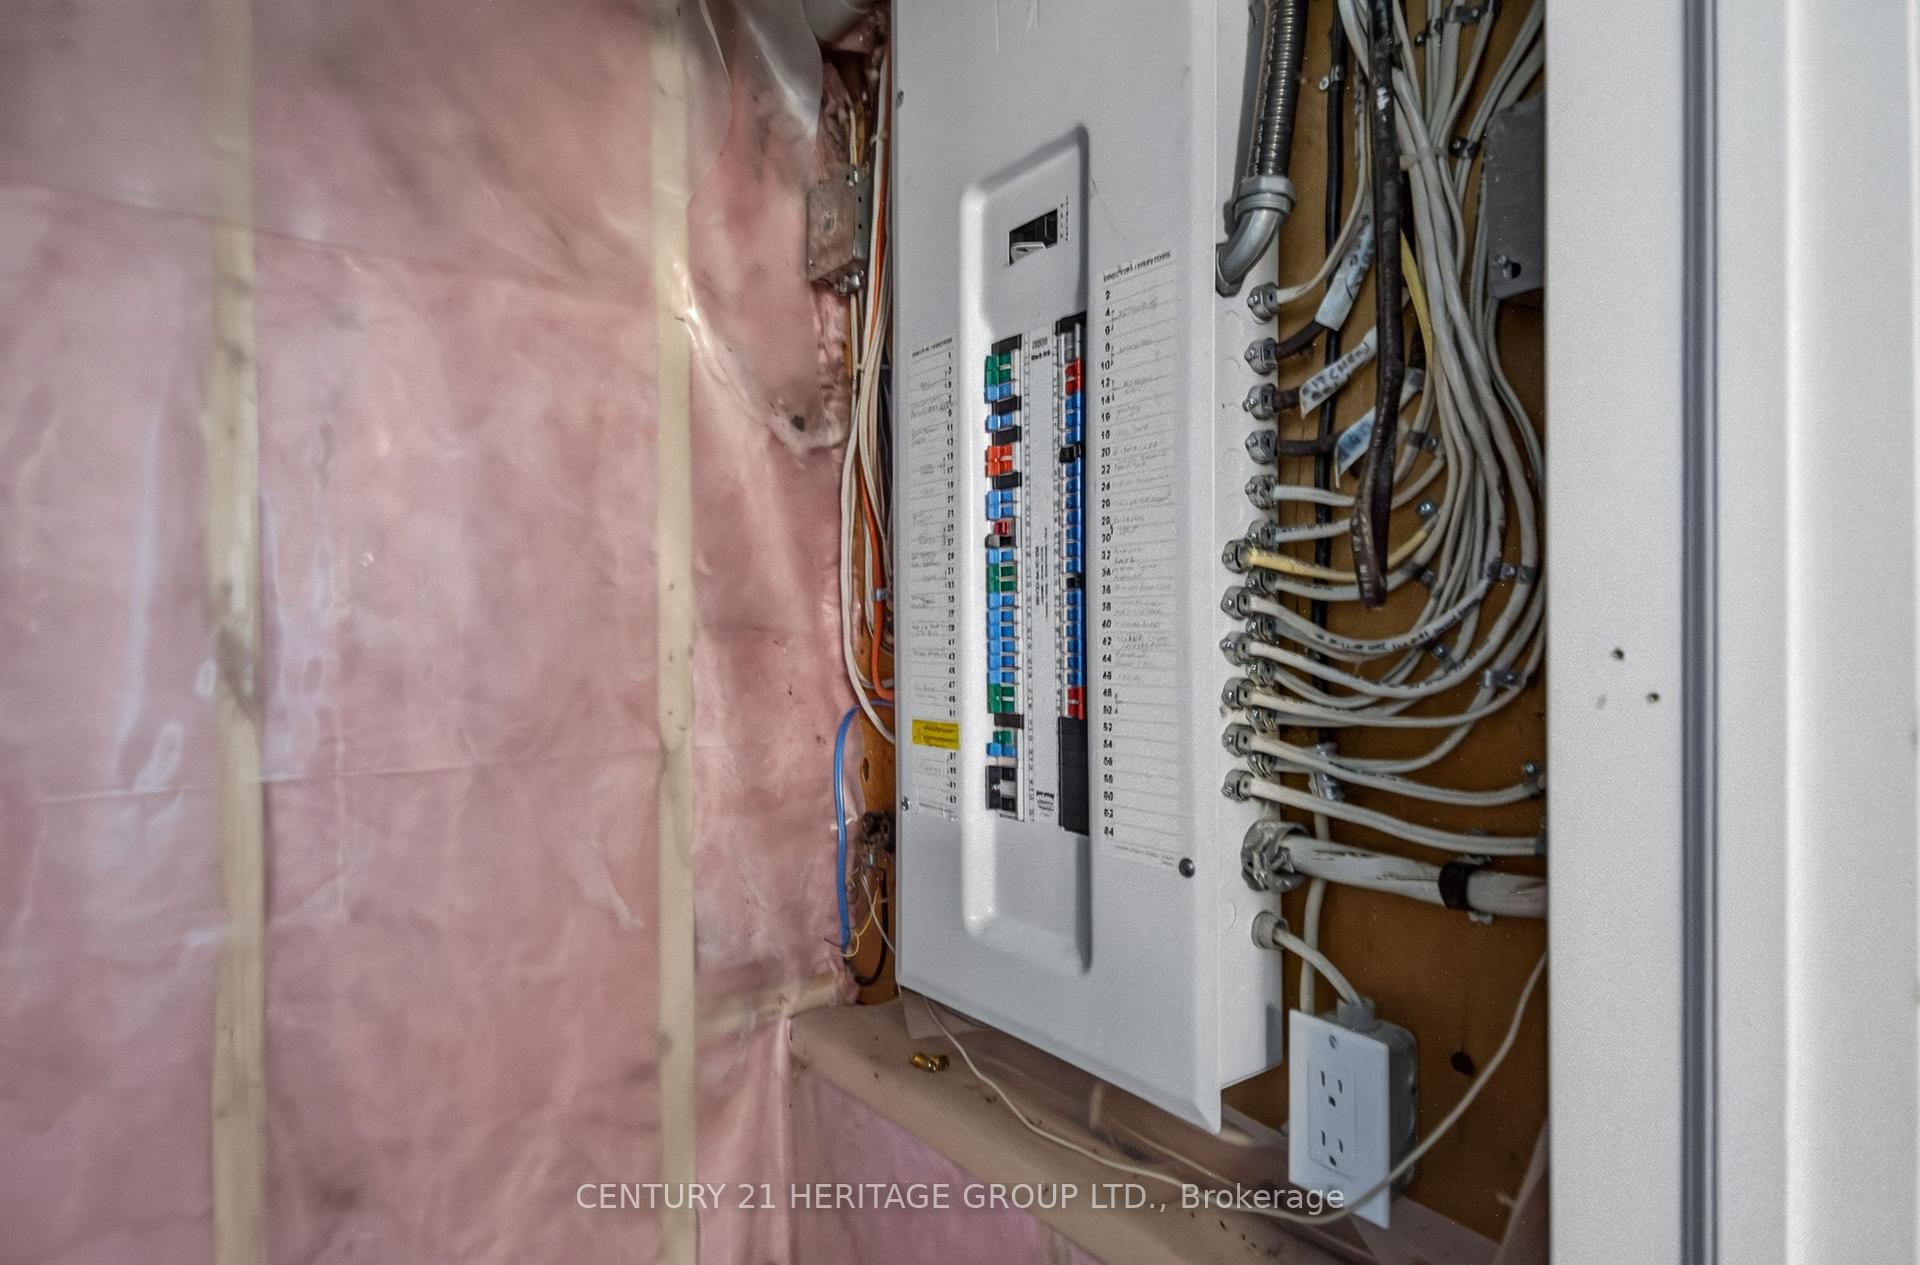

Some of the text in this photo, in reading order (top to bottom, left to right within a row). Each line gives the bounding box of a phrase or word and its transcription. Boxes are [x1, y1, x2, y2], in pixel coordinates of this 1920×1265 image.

[1105, 289, 1111, 301] 2
[1100, 359, 1111, 371] 10
[1101, 618, 1112, 629] 40
